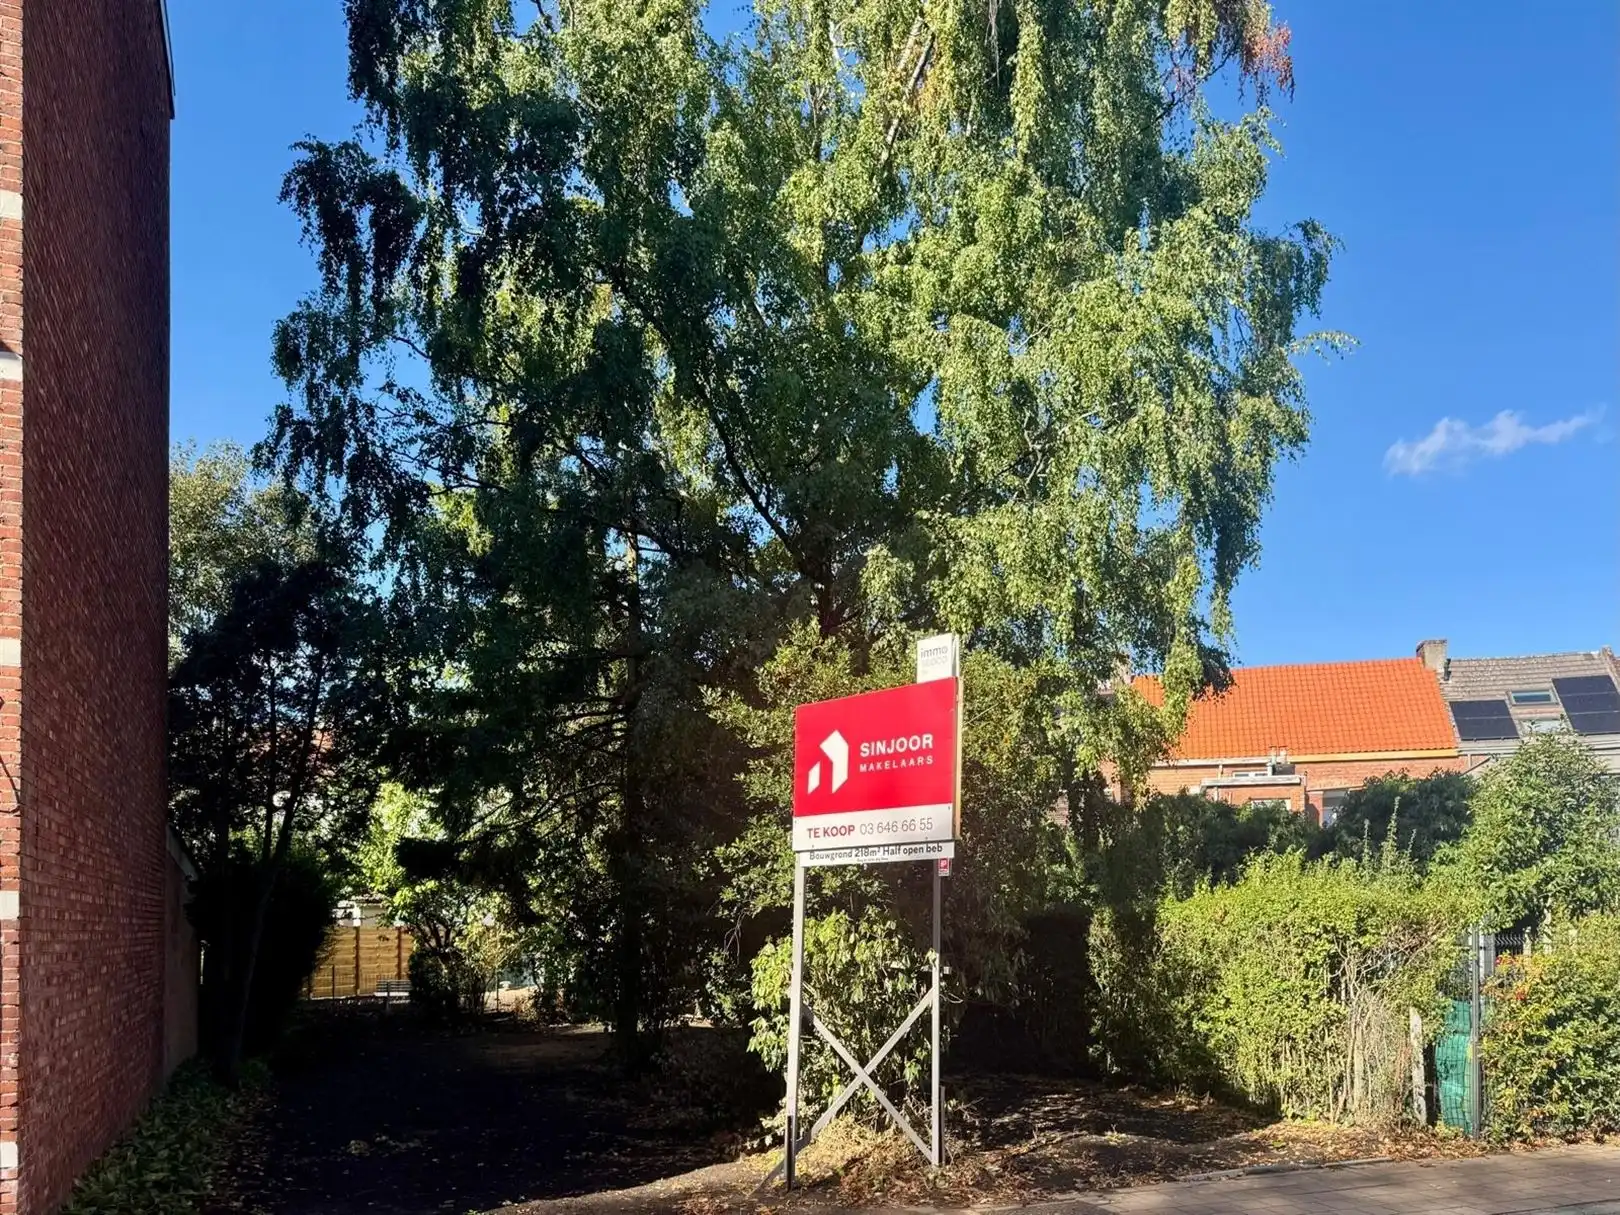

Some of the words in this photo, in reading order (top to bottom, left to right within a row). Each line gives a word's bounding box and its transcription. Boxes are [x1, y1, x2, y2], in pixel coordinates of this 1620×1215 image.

[921, 646, 949, 658] immo
[860, 733, 933, 757] SINJOOR
[860, 755, 933, 772] MAKELAARS
[807, 827, 820, 839] TE
[823, 825, 856, 838] KOOP
[859, 823, 874, 835] 03
[877, 820, 898, 834] 646
[901, 818, 916, 832] 66
[920, 817, 933, 831] 55
[809, 849, 853, 861] Bouwgrond
[883, 845, 901, 856] Half
[903, 846, 924, 856] open
[926, 842, 943, 853] beb
